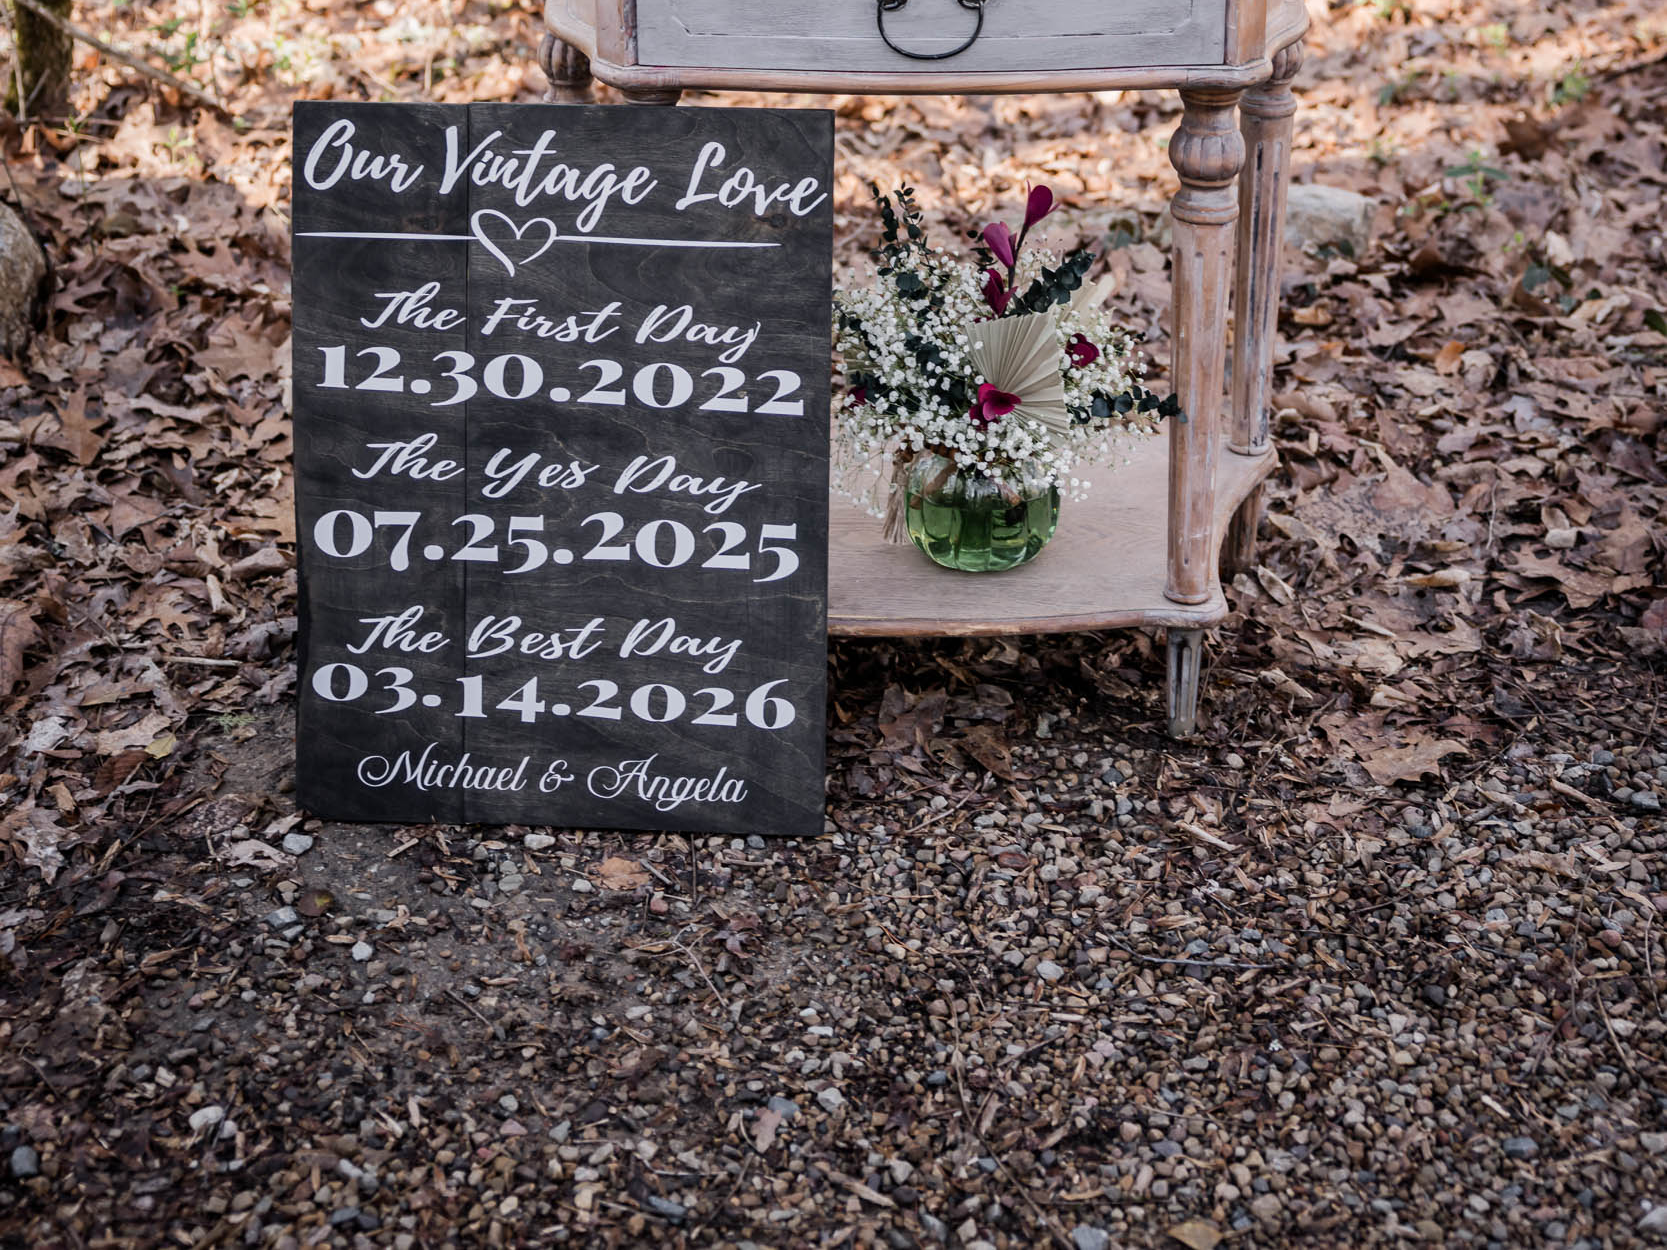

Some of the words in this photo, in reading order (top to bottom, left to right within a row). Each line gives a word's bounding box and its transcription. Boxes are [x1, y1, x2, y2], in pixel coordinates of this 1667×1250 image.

[304, 119, 424, 192] Our
[439, 126, 658, 232] Vintage
[676, 142, 827, 216] Love
[361, 282, 466, 330] The
[481, 298, 622, 342] First
[635, 305, 761, 363] Day
[317, 345, 803, 415] 12.30.2022
[352, 433, 464, 480] The
[482, 448, 600, 498] Yes
[614, 456, 762, 514] Day
[314, 510, 799, 582] 07.25.2025
[347, 606, 450, 653] The
[467, 616, 605, 659] Best
[620, 618, 742, 673] Day
[313, 663, 795, 729] 03.14.2026
[358, 742, 530, 791] Michael
[540, 760, 574, 792] &
[587, 753, 747, 811] Angela
